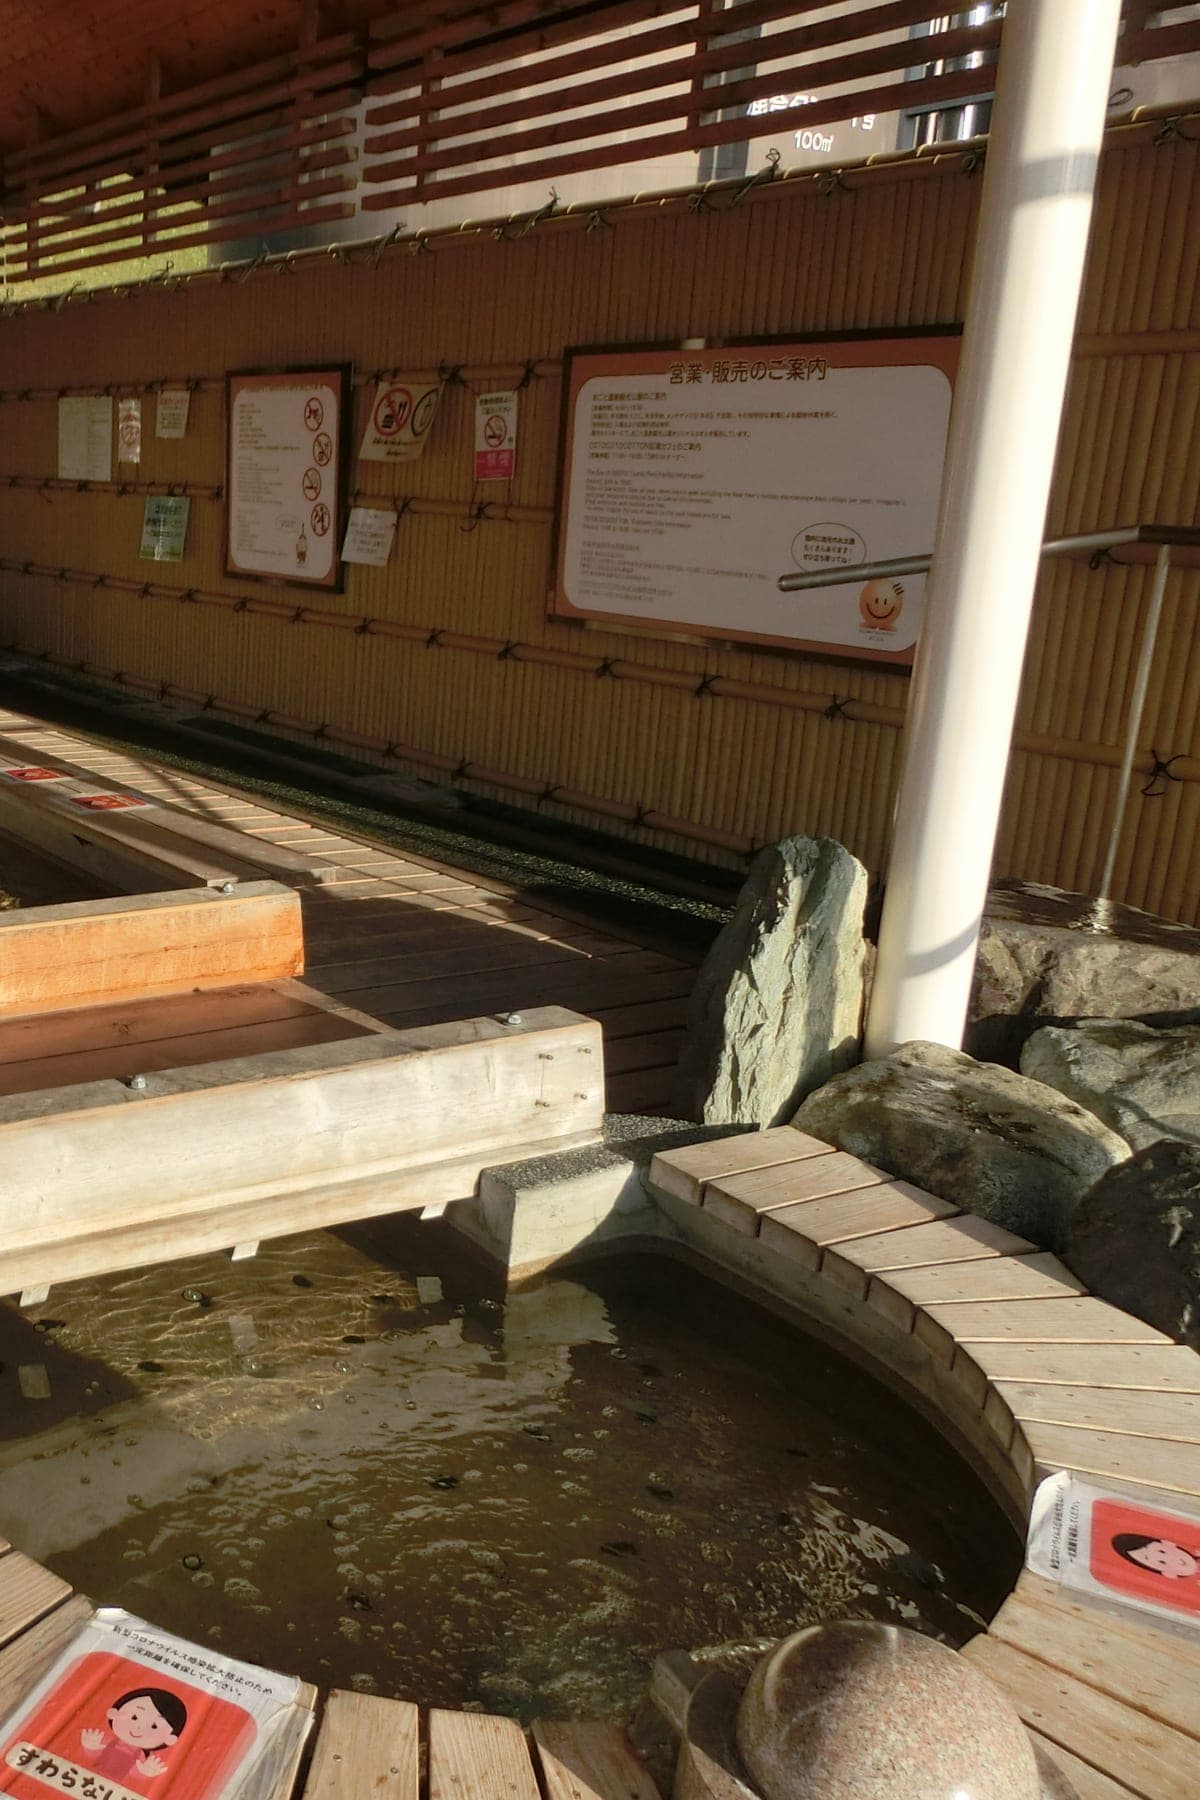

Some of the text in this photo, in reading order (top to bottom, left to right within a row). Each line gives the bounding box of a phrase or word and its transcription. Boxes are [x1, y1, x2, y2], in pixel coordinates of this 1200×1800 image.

[668, 358, 828, 384] 営業・販売のご案内
